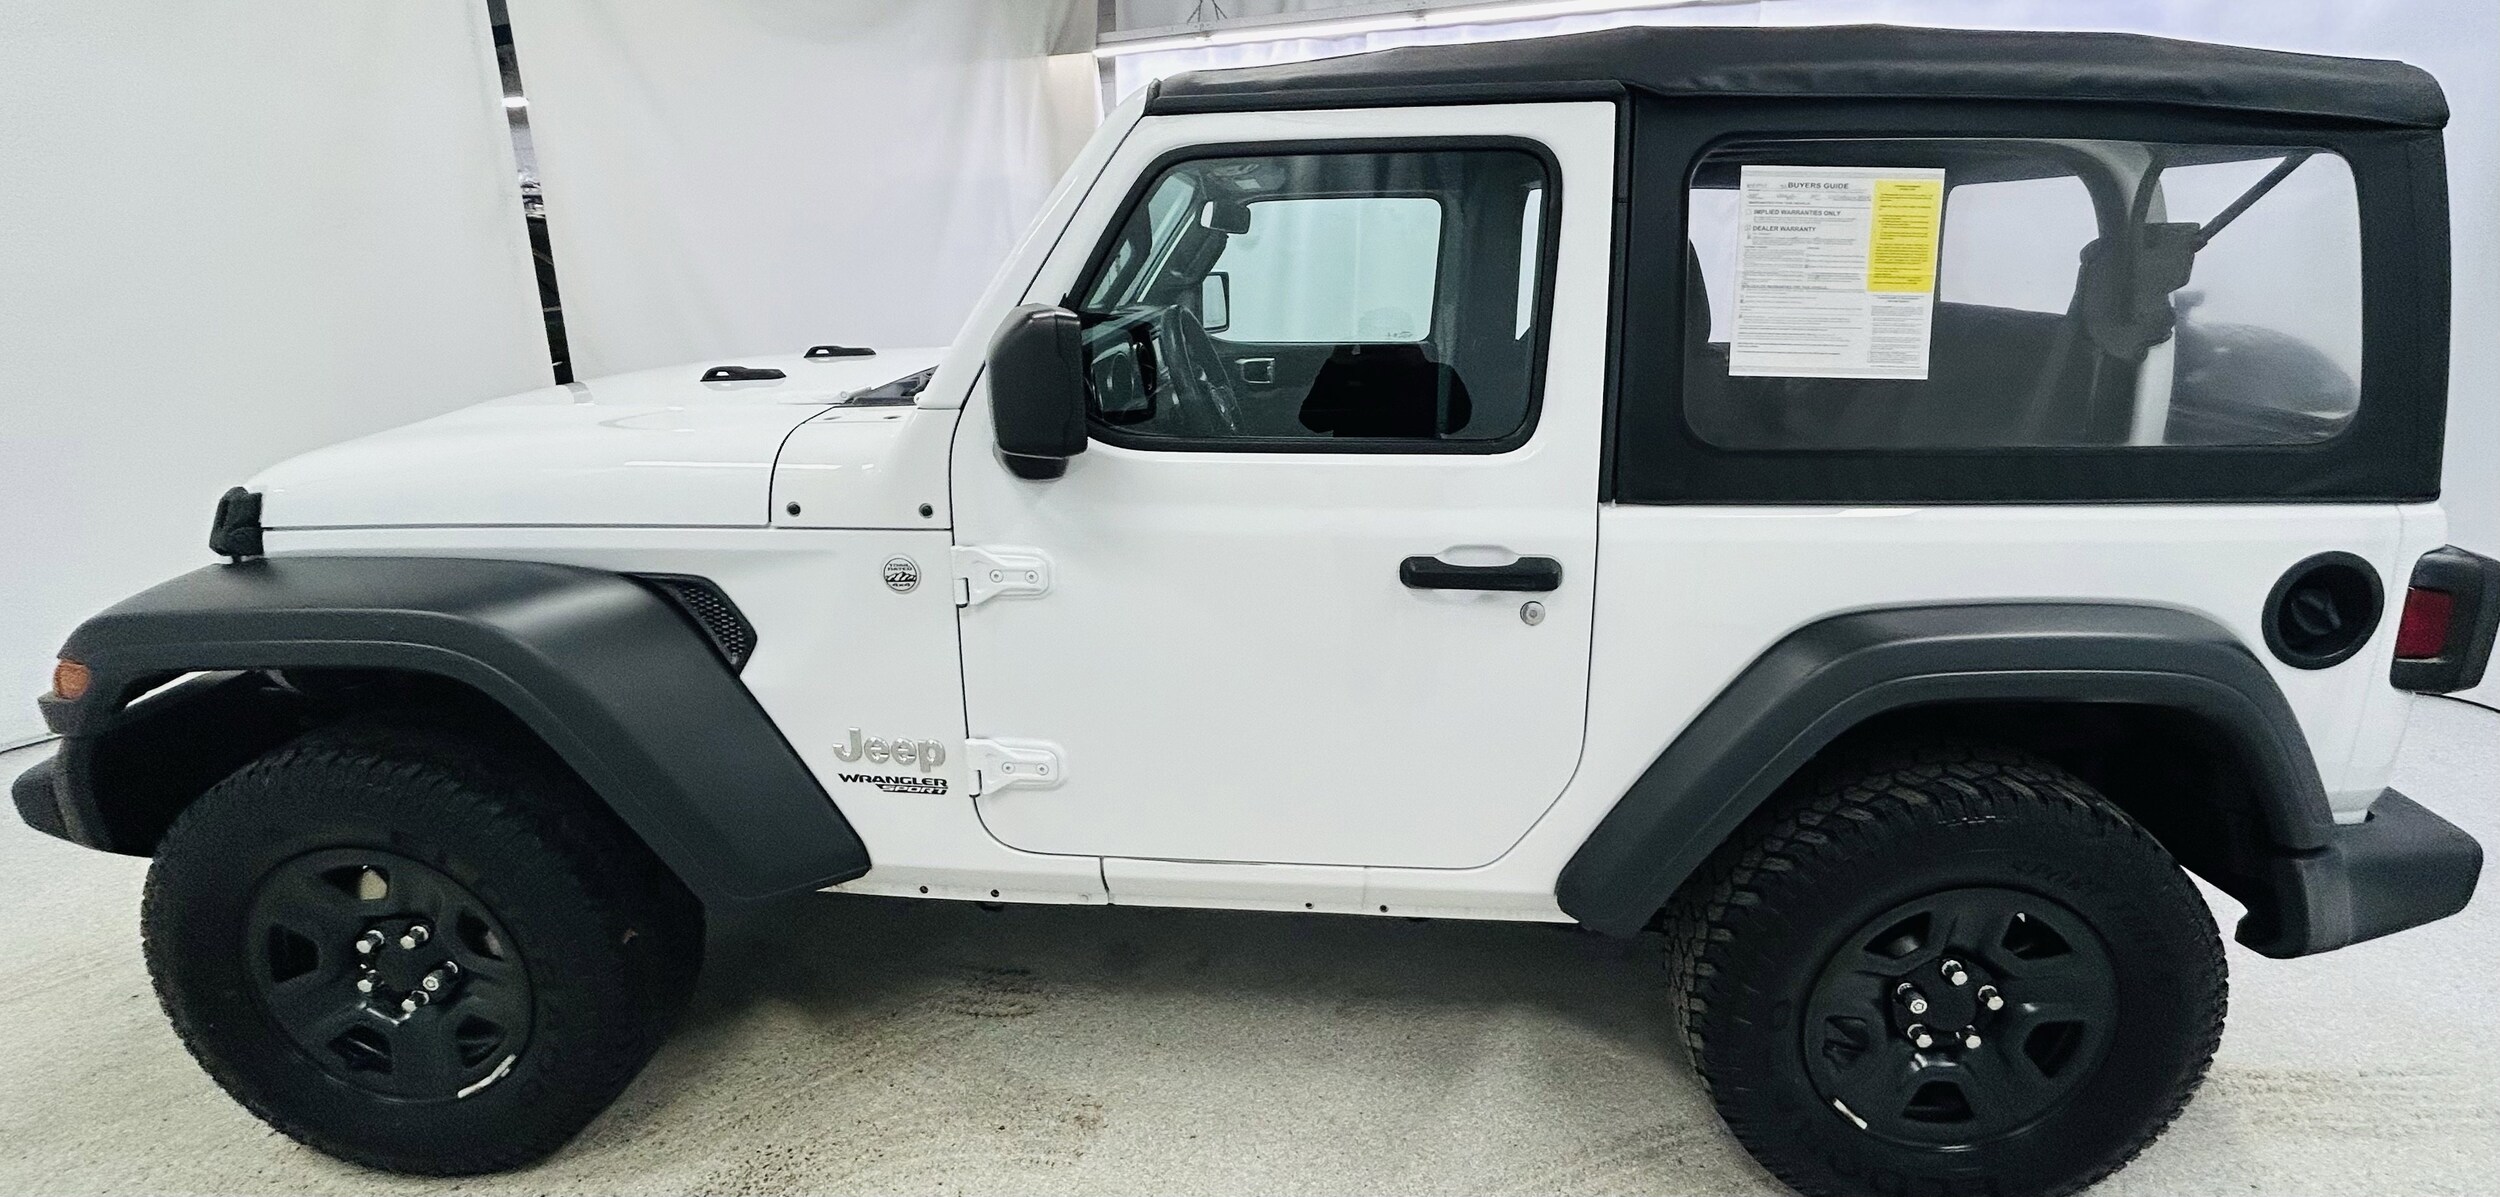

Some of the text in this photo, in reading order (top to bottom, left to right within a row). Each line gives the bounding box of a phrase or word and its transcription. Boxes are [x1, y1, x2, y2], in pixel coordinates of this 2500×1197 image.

[832, 726, 946, 773] Jeep
[838, 773, 947, 787] WRANGLER
[881, 784, 947, 794] SPORT
